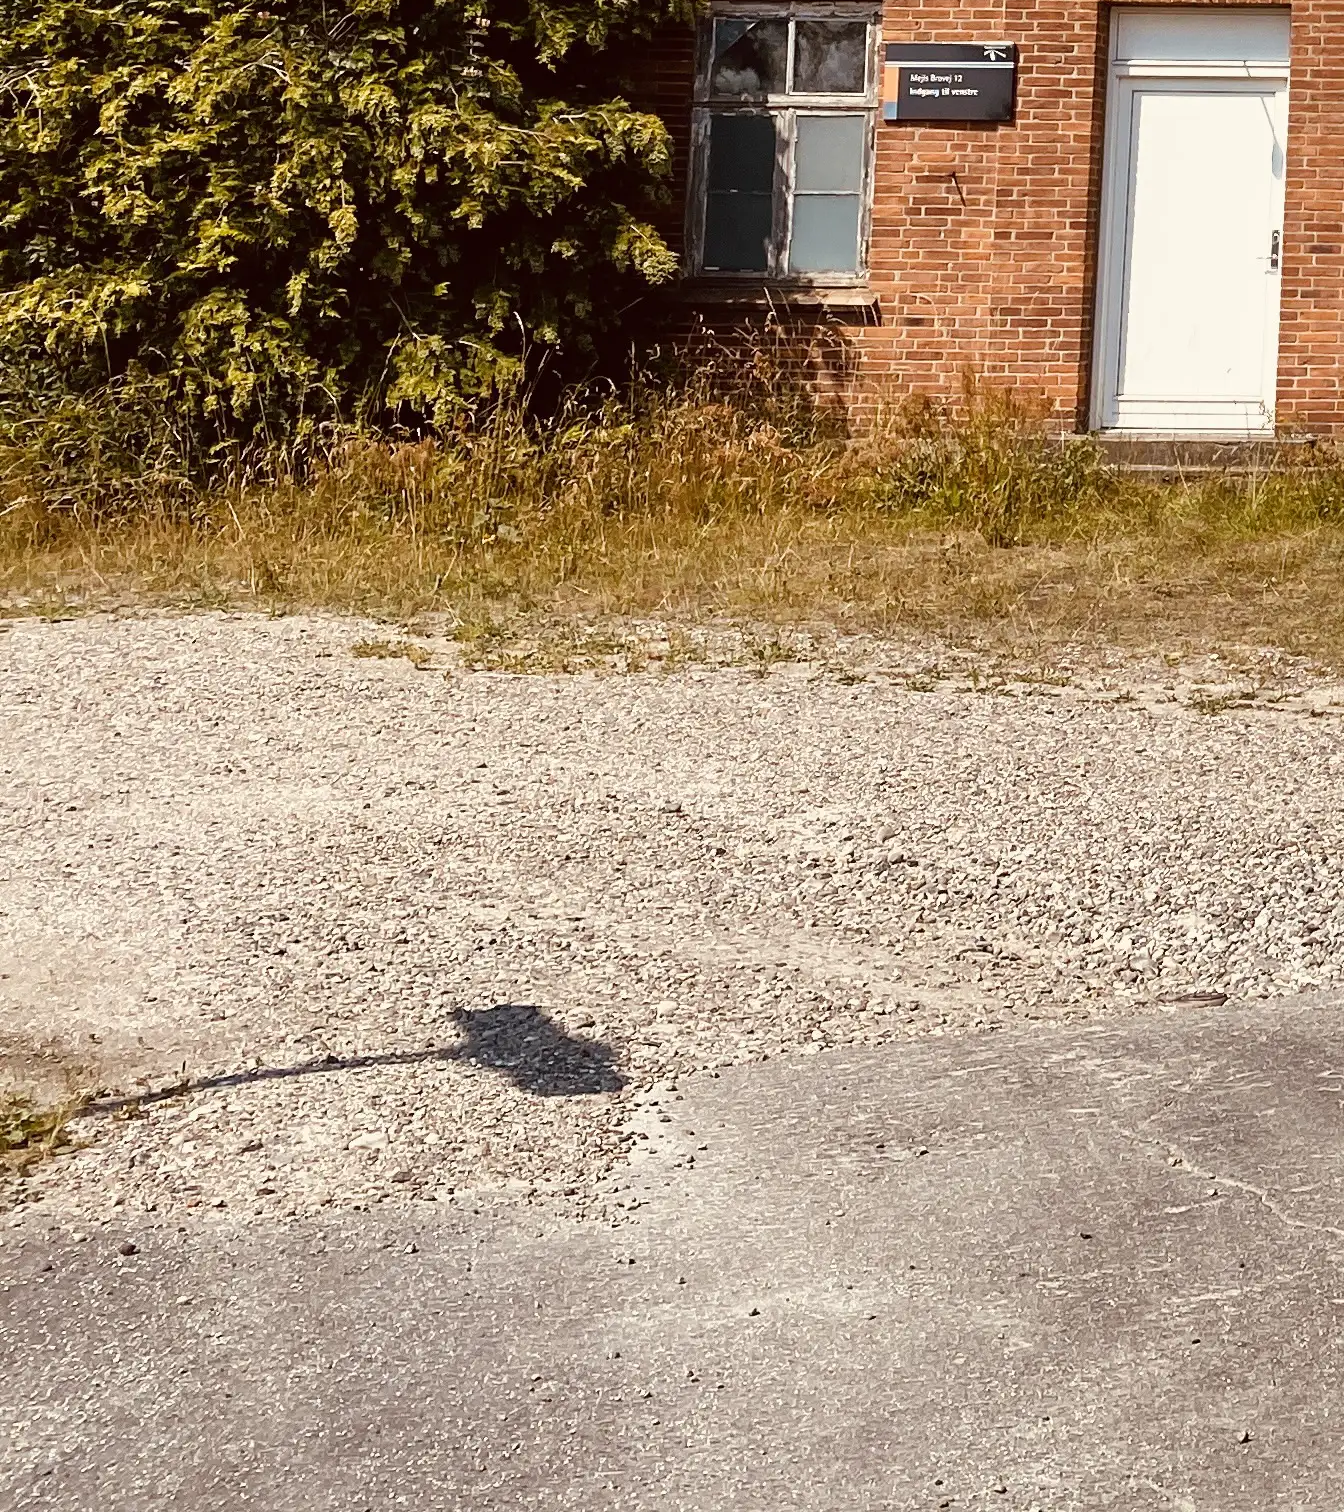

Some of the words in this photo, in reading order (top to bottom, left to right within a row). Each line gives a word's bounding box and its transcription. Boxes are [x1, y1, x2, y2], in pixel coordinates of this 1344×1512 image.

[930, 74, 952, 84] Brovej
[954, 74, 963, 83] 12
[909, 87, 940, 98] Indgang
[941, 87, 950, 96] til
[951, 88, 979, 96] venstre
